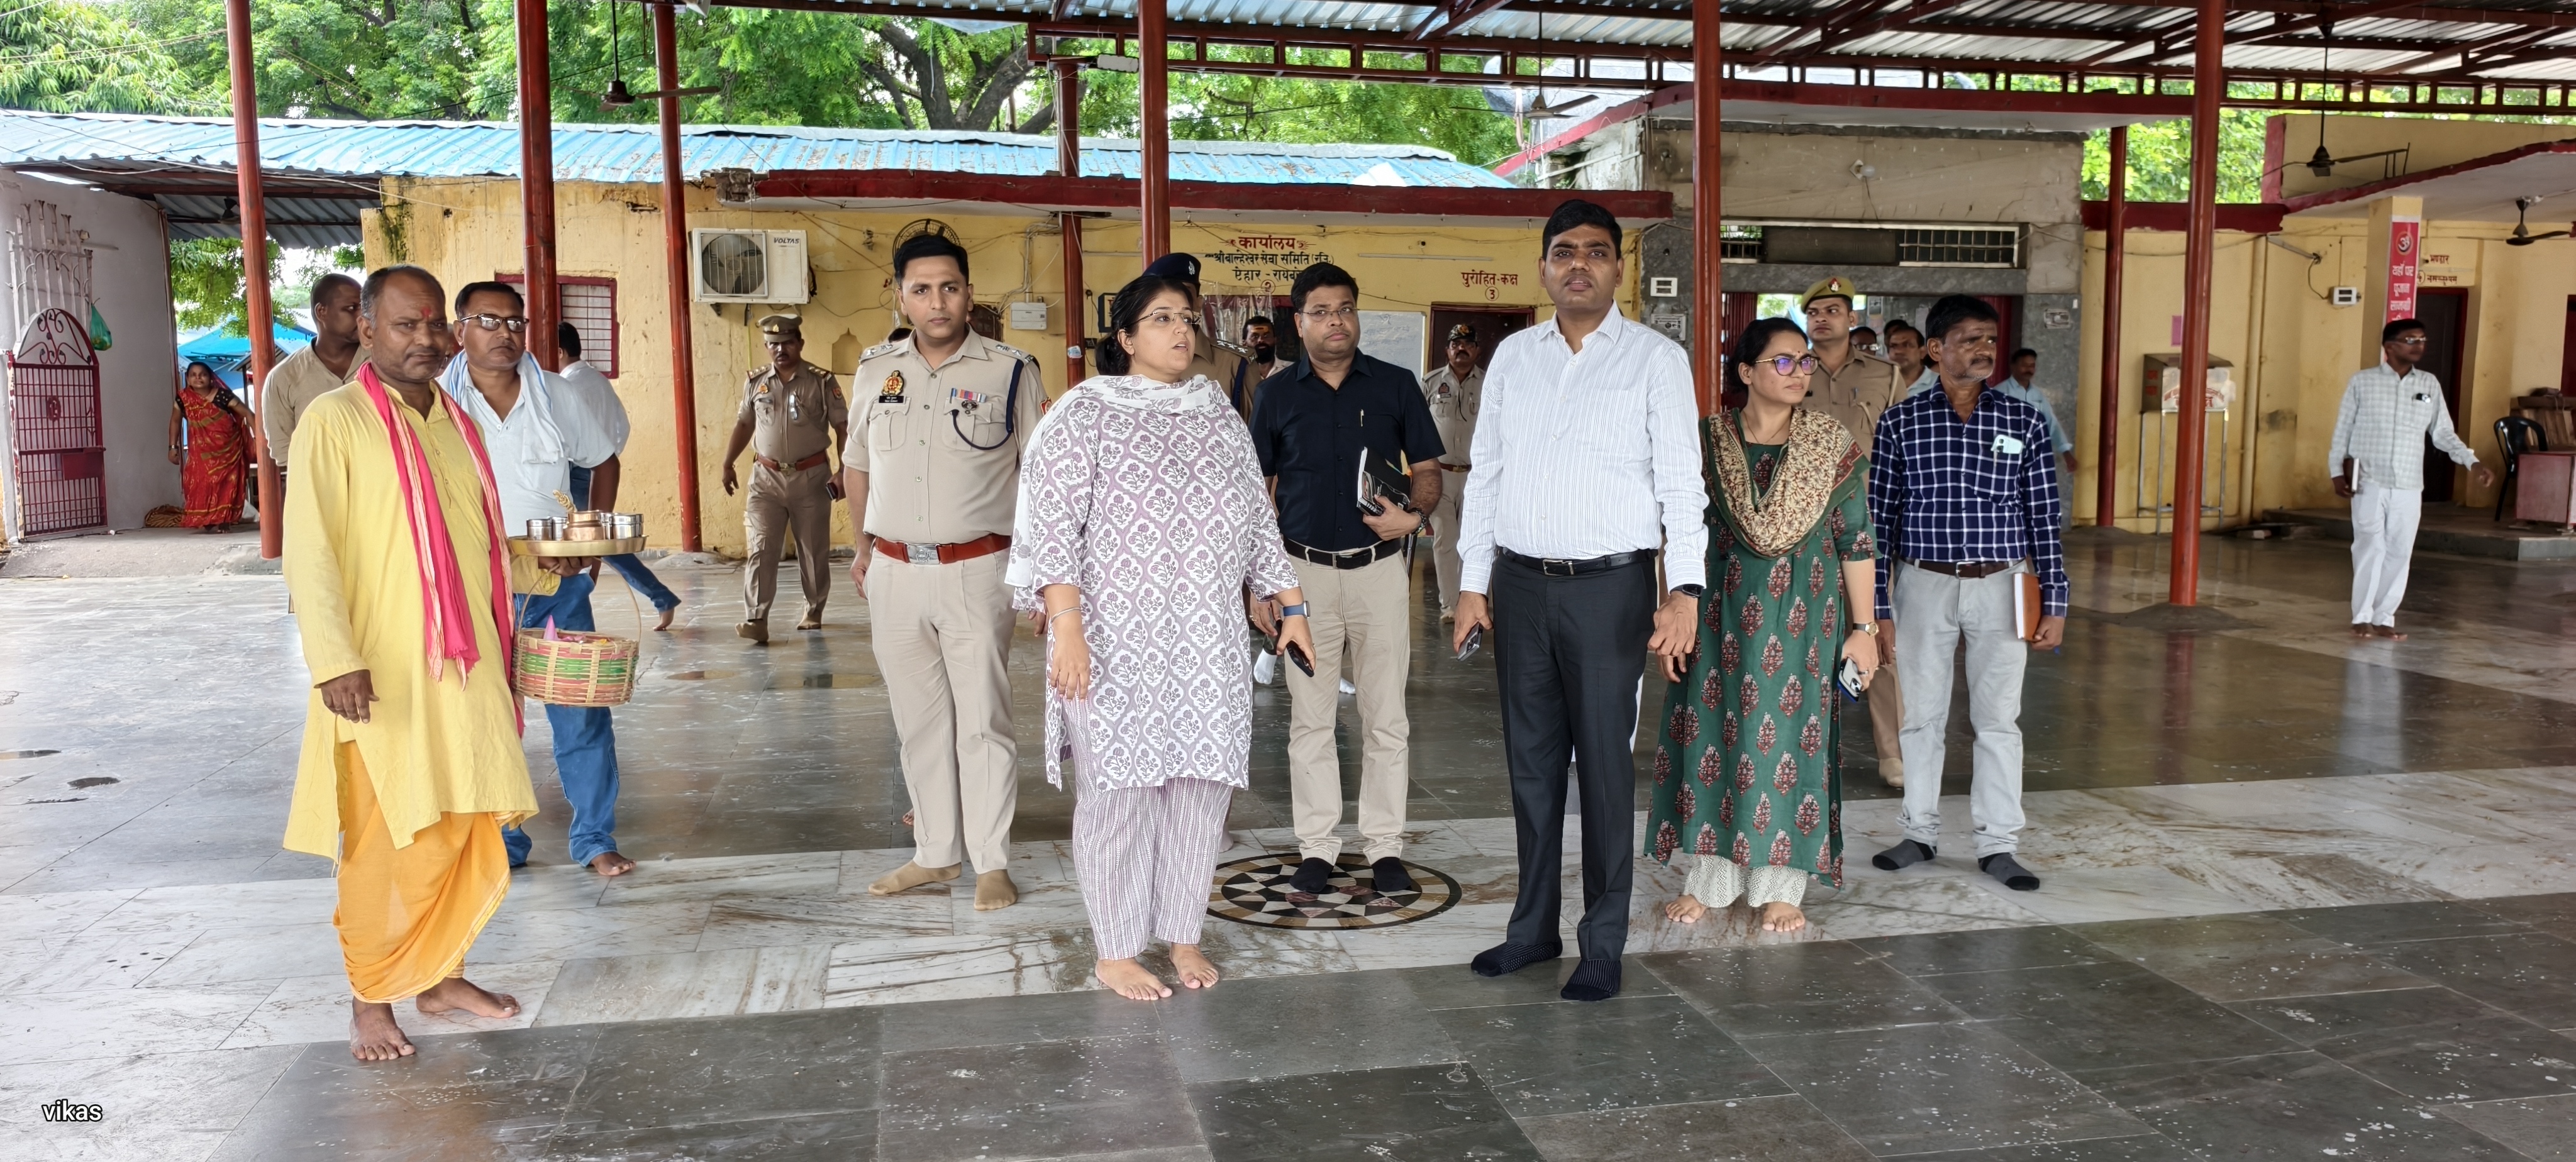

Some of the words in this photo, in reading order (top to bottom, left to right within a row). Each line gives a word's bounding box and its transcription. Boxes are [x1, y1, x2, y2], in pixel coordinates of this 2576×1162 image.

[1238, 235, 1296, 250] कार्यालय
[1260, 250, 1278, 265] सेवा
[1280, 251, 1309, 265] समिति
[1232, 266, 1261, 285] ऐहार
[1461, 269, 1518, 287] पुरोहित-कक्ष
